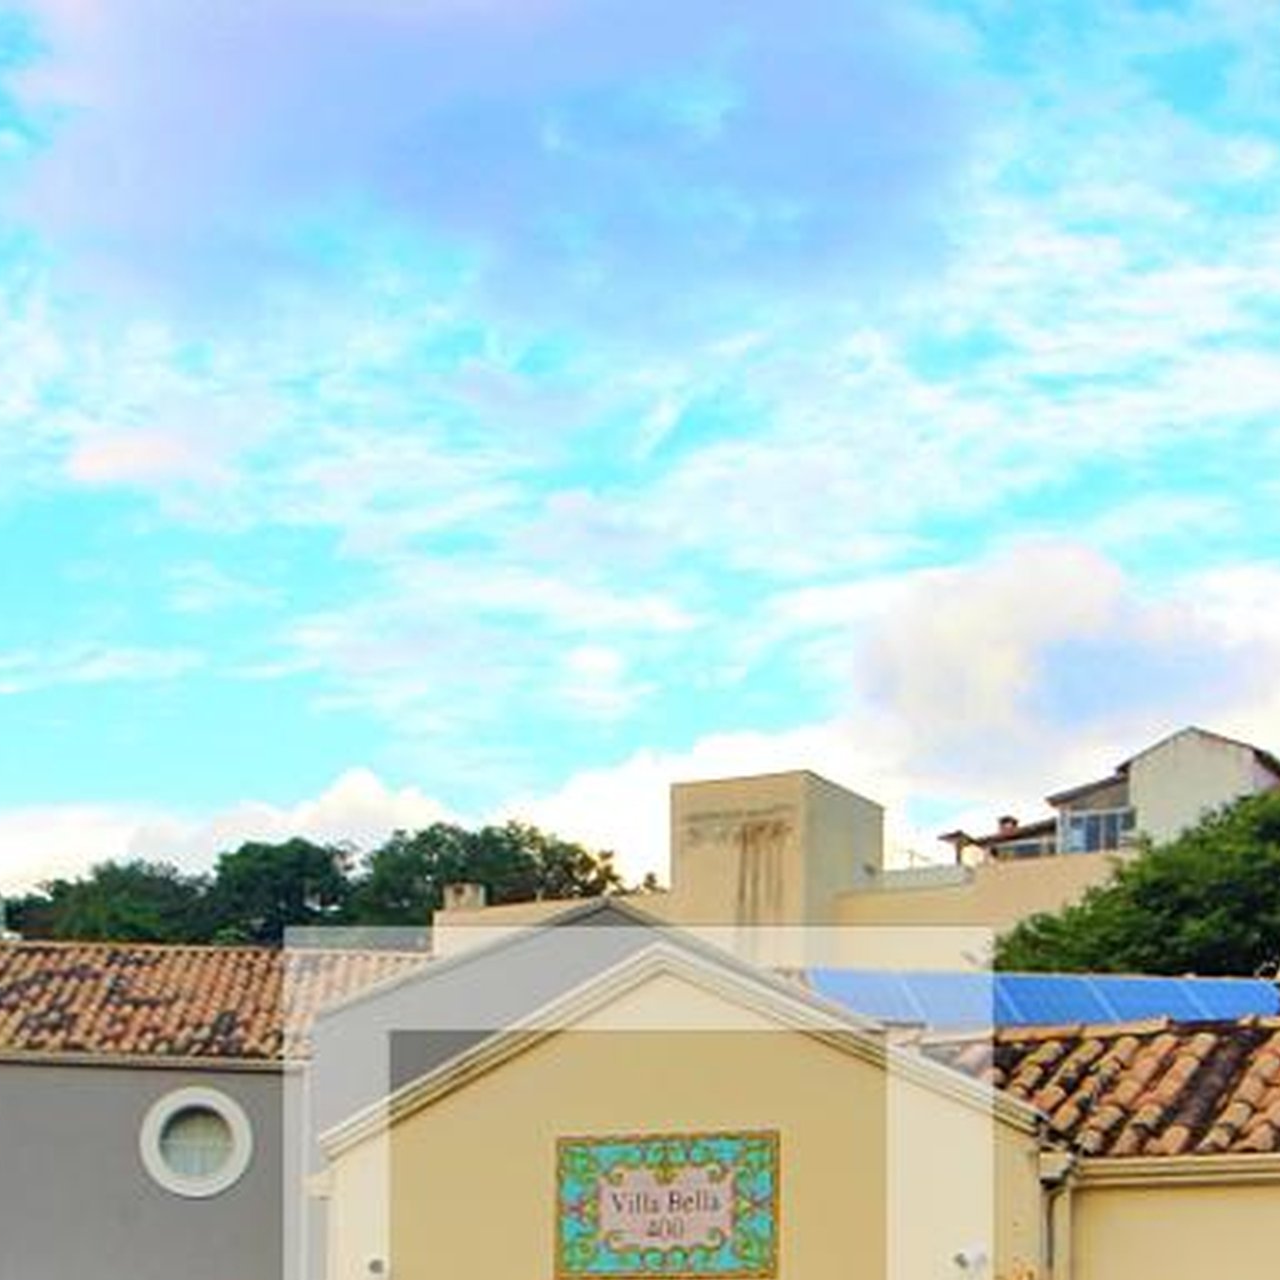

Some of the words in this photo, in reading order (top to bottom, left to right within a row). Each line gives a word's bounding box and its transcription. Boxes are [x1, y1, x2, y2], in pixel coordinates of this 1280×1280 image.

[609, 1190, 658, 1213] Villa
[669, 1189, 721, 1212] Bella
[646, 1217, 685, 1237] 400
